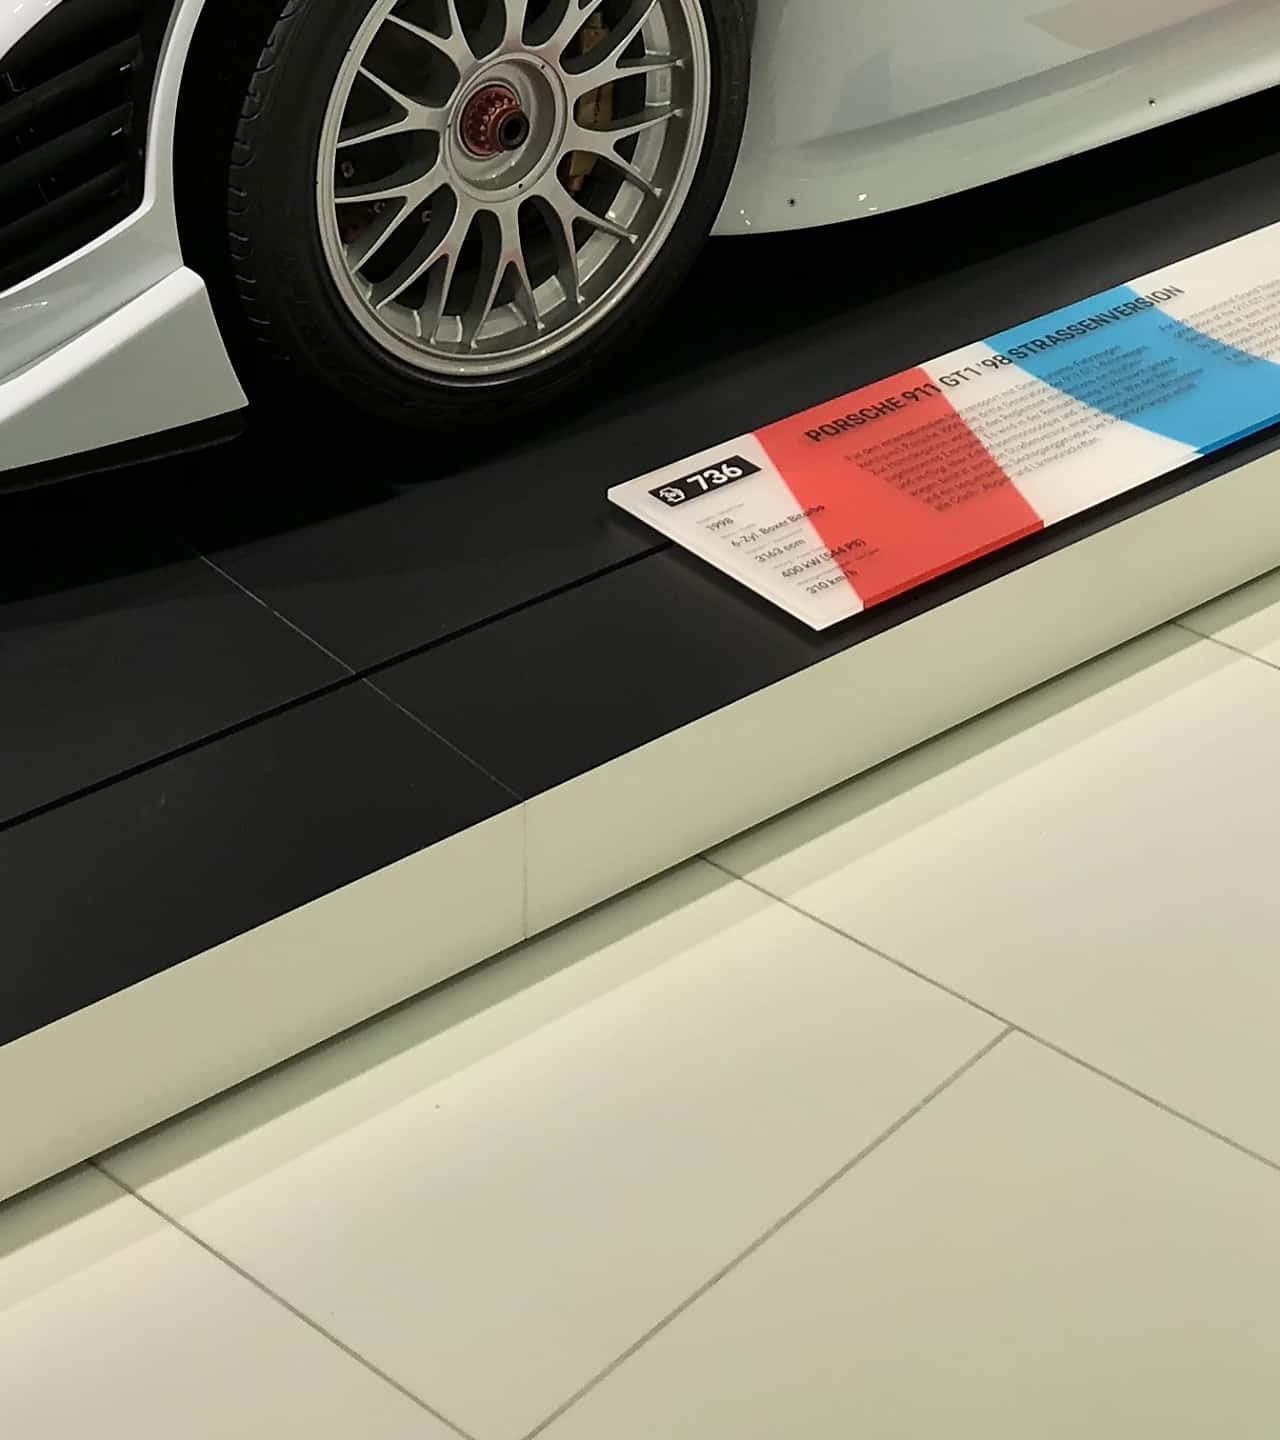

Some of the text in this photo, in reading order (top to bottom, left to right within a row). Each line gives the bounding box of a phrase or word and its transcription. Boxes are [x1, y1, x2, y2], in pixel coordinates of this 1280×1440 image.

[803, 396, 907, 442] PORSCHE
[901, 382, 944, 404] 911
[938, 366, 982, 389] GT1
[1005, 284, 1185, 359] STRASSENVERSION
[686, 463, 744, 491] 736
